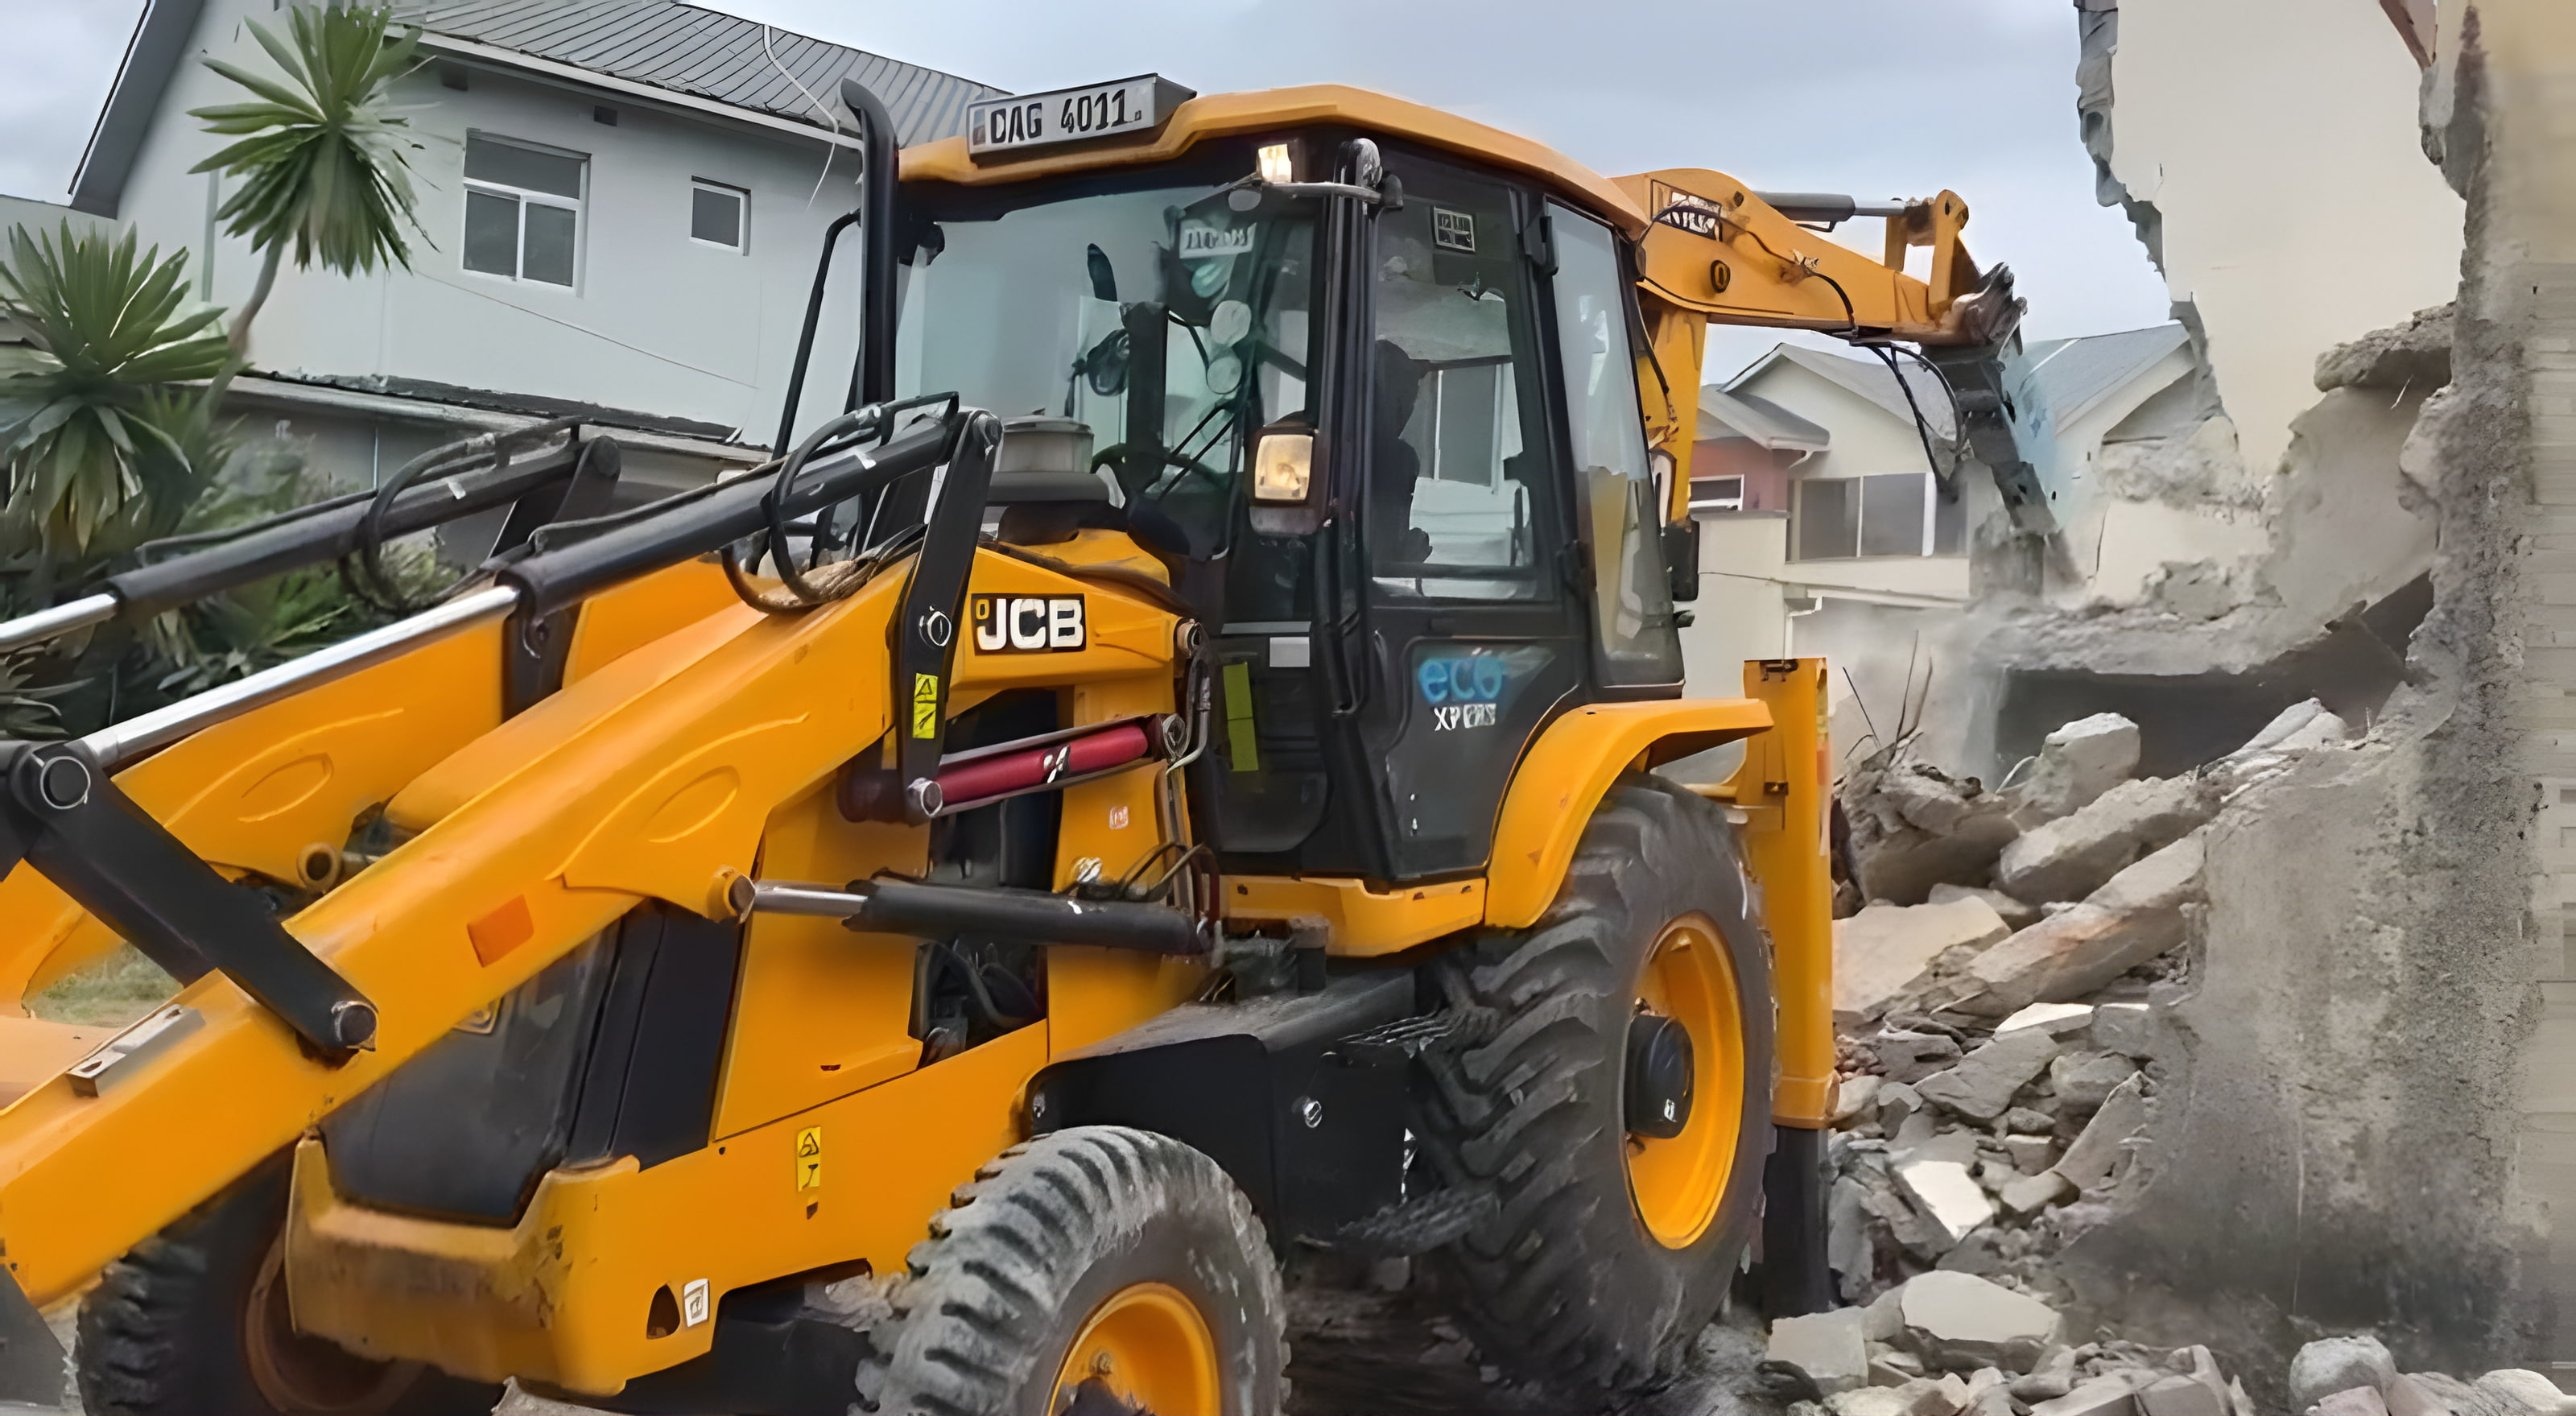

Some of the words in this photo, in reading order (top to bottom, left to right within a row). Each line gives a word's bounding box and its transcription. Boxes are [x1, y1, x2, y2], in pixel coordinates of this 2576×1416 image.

[990, 102, 1043, 144] DAG
[1060, 88, 1126, 133] 4011
[976, 598, 1084, 650] JCB
[1418, 657, 1503, 703] eco
